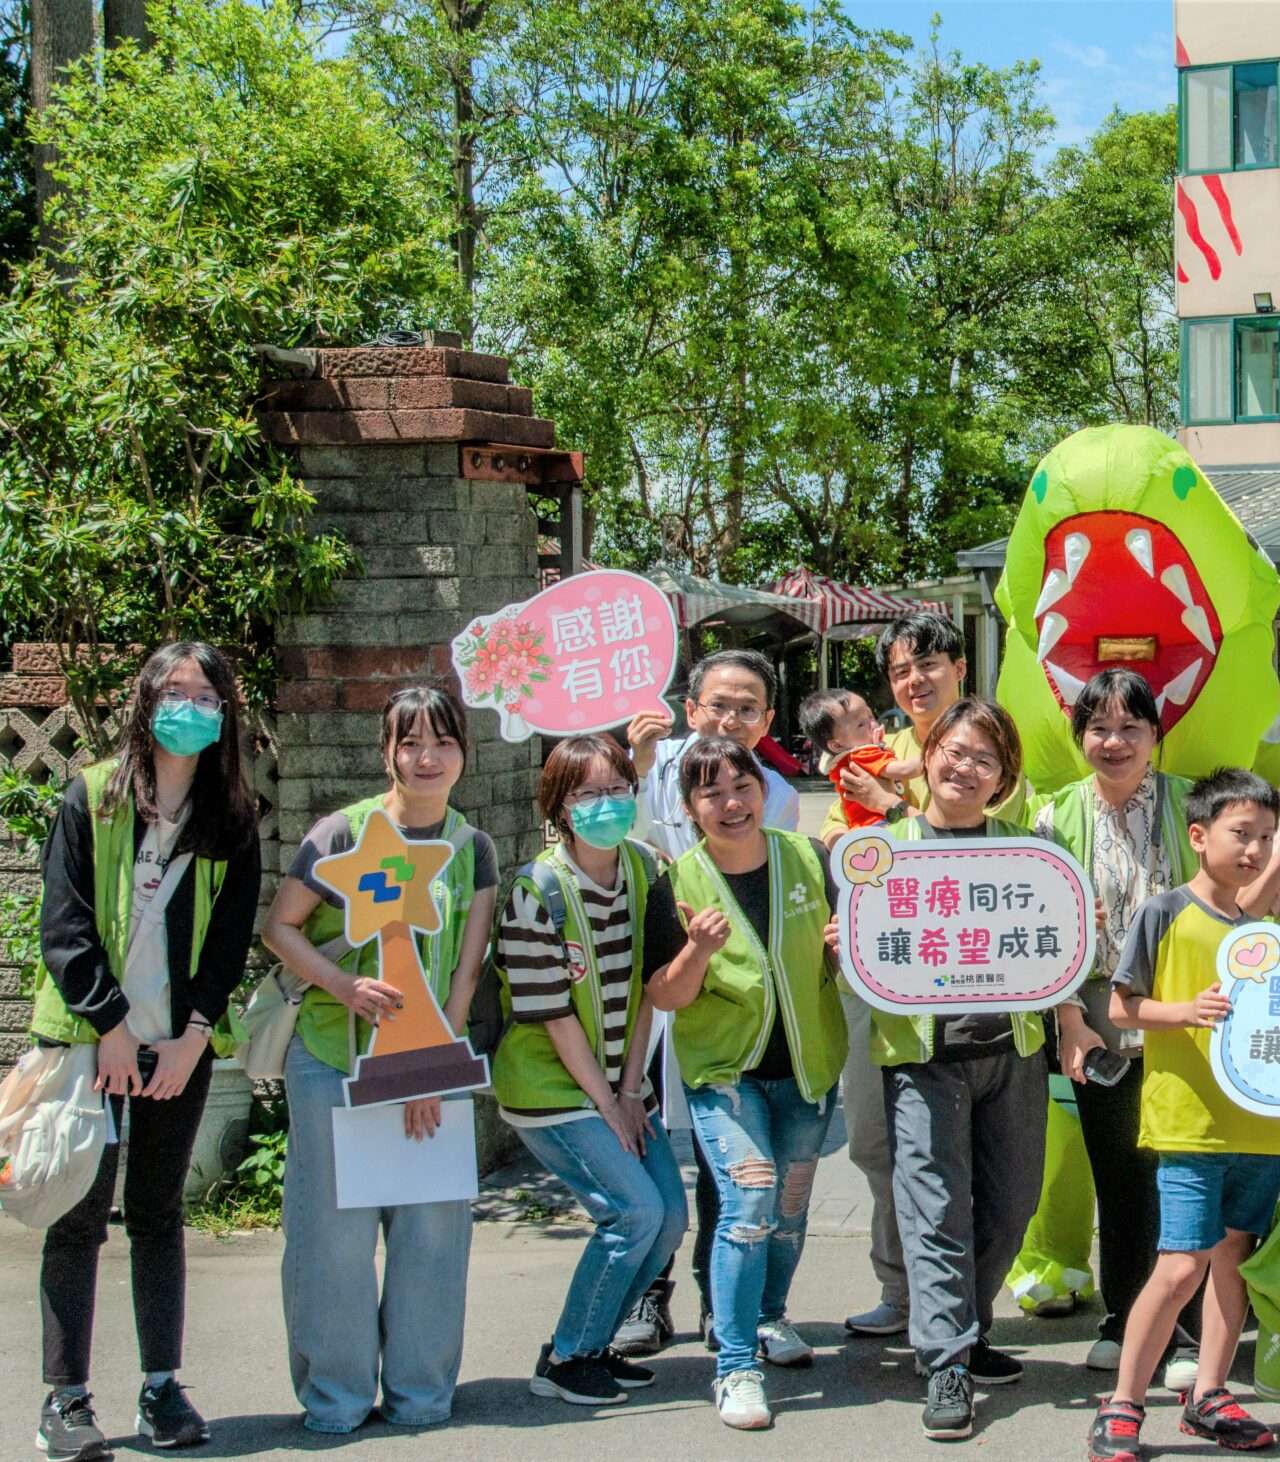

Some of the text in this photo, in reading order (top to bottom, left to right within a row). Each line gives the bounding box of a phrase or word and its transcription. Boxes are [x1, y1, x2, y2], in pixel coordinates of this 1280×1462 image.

[551, 594, 646, 656] 感謝
[558, 645, 656, 704] 有您
[876, 925, 1062, 967] 讓希望成真
